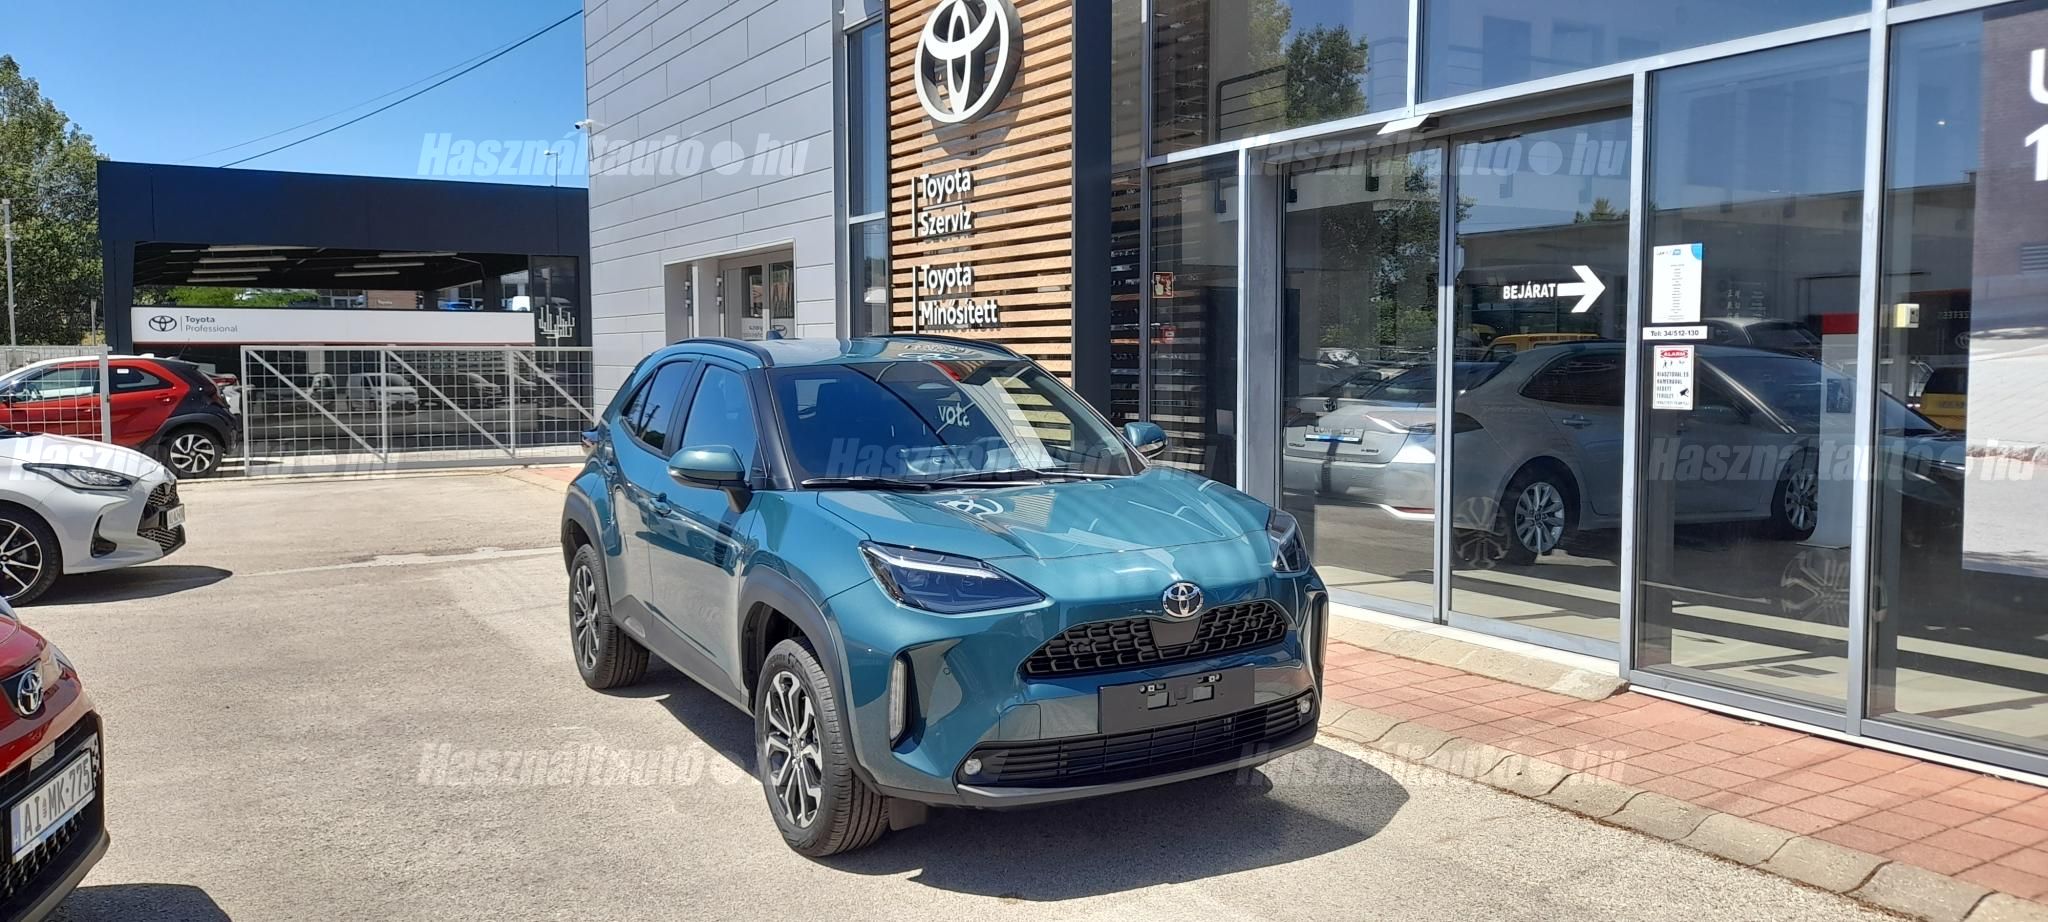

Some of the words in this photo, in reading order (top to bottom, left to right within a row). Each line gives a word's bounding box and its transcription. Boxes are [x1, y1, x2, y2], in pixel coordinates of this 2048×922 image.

[920, 168, 971, 203] Toyota
[921, 205, 972, 236] Szerviz
[921, 262, 972, 295] Toyota
[1503, 281, 1556, 300] BEJÁRAT
[185, 315, 215, 324] Toyota
[920, 298, 998, 325] Minősített
[185, 324, 238, 333] Professional
